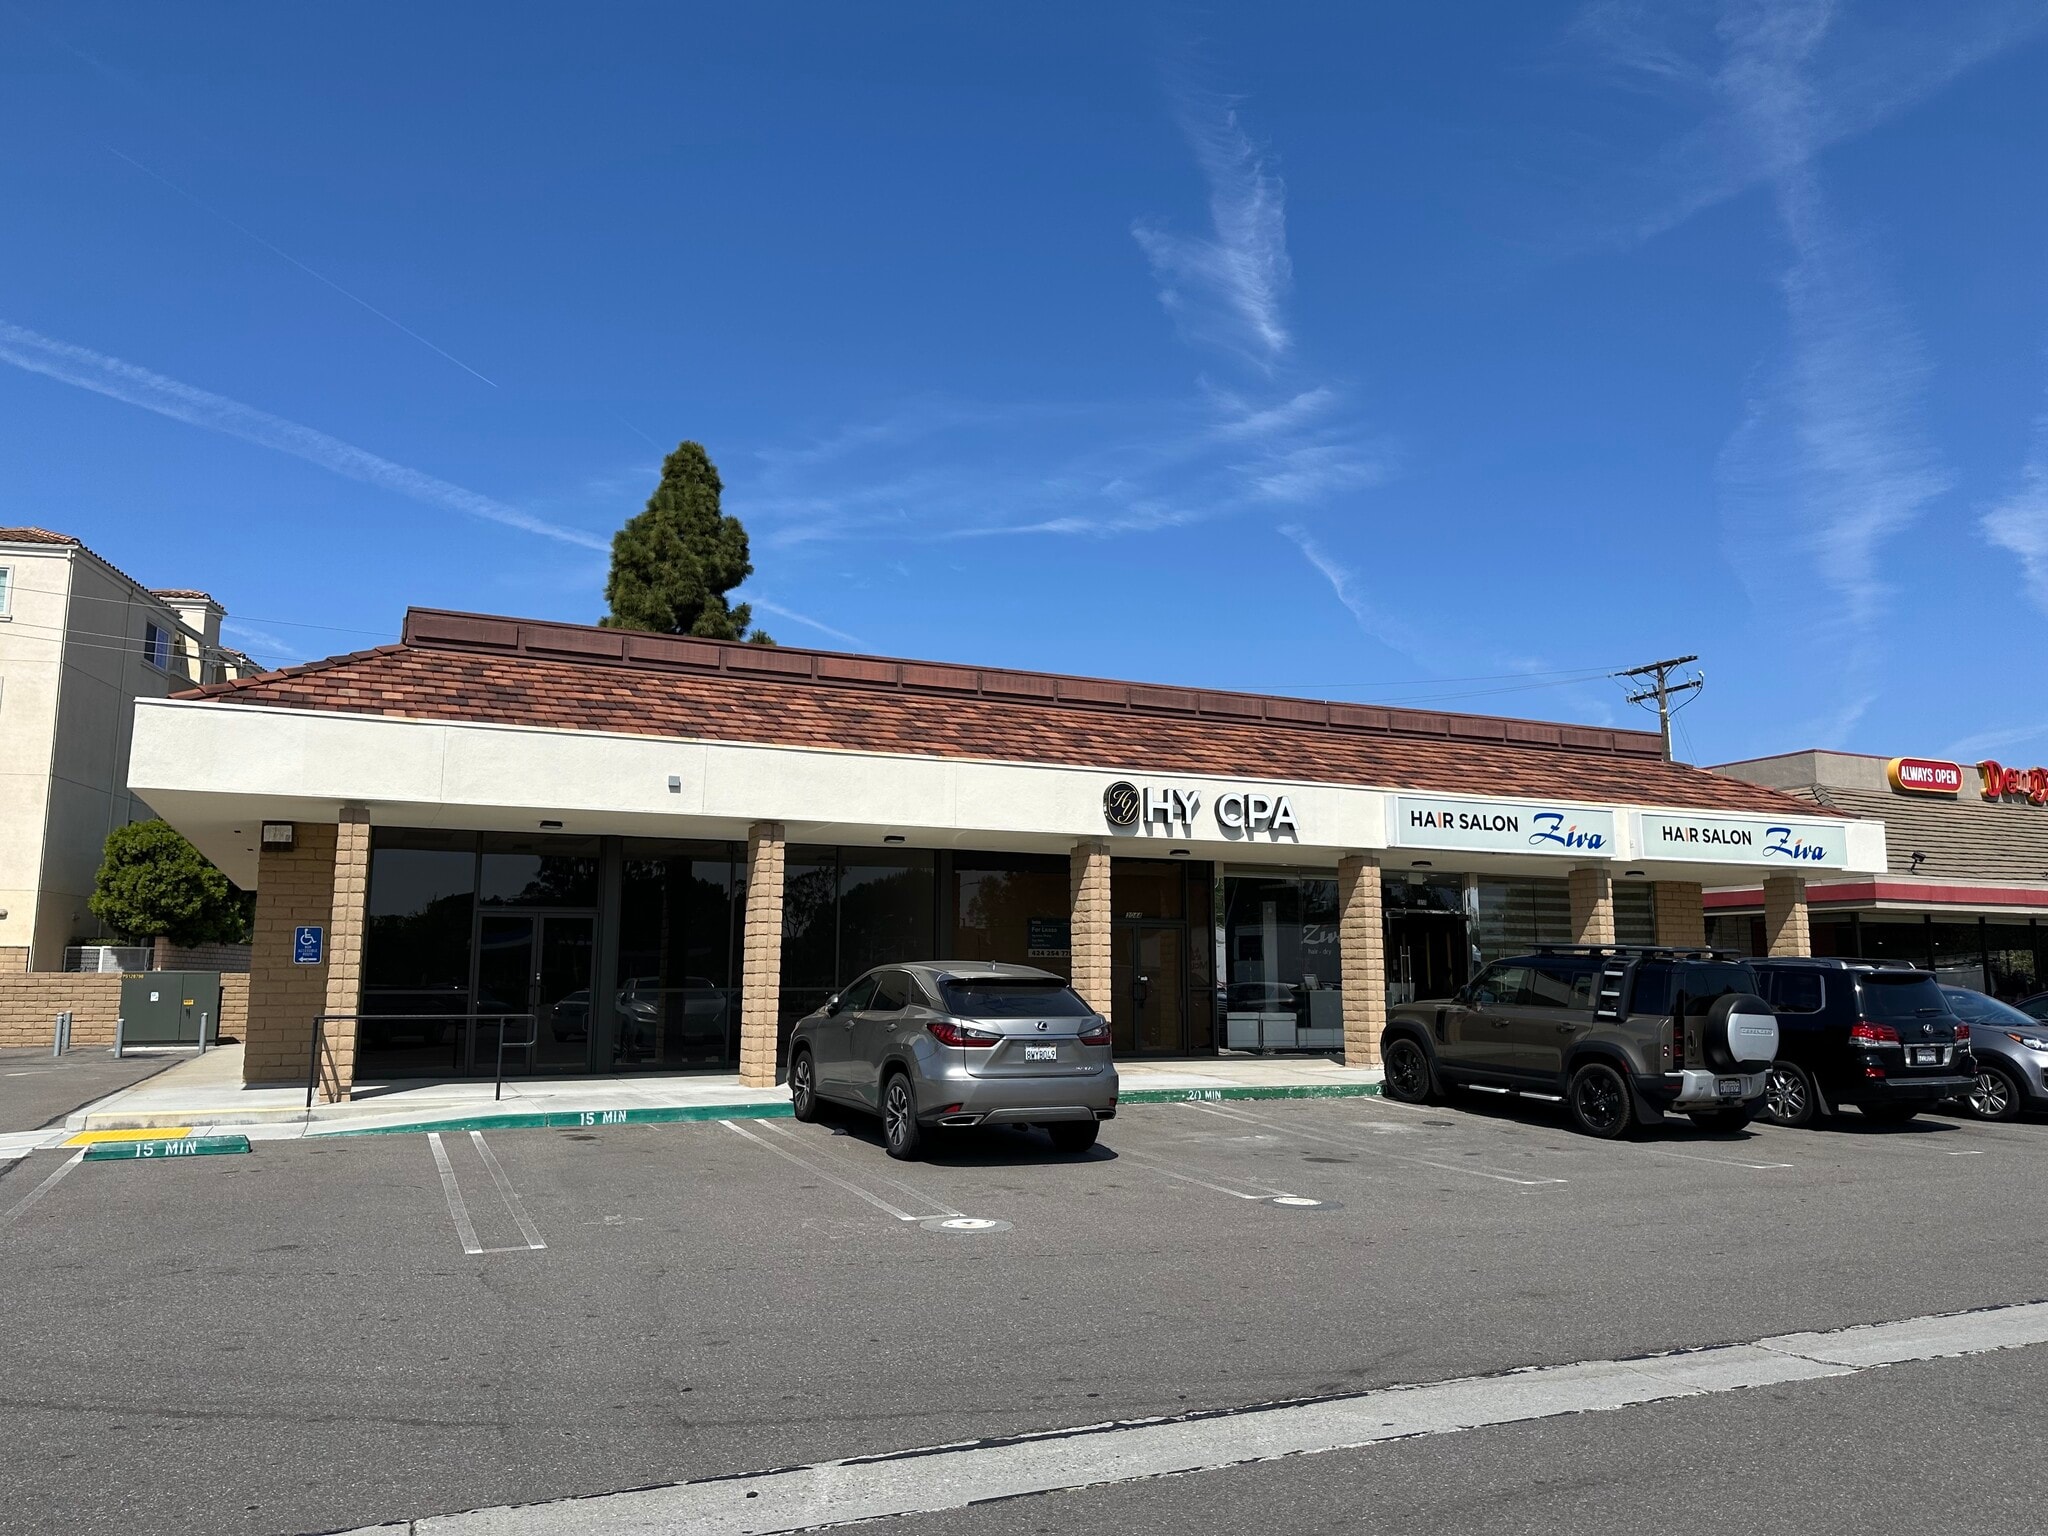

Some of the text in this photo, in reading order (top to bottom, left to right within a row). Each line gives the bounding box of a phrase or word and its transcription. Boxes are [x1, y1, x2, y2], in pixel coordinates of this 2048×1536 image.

[1901, 766, 1957, 784] ALWAYS OPEN
[1145, 787, 1300, 830] HY CPA
[1411, 810, 1519, 832] HAIR SALON
[1529, 812, 1606, 849] Ziva
[1662, 826, 1752, 845] HAIR SALON
[1763, 827, 1827, 860] Ziva
[1205, 1090, 1221, 1100] MIN
[580, 1110, 627, 1126] 15 MIN
[135, 1141, 197, 1158] 15 MIN
